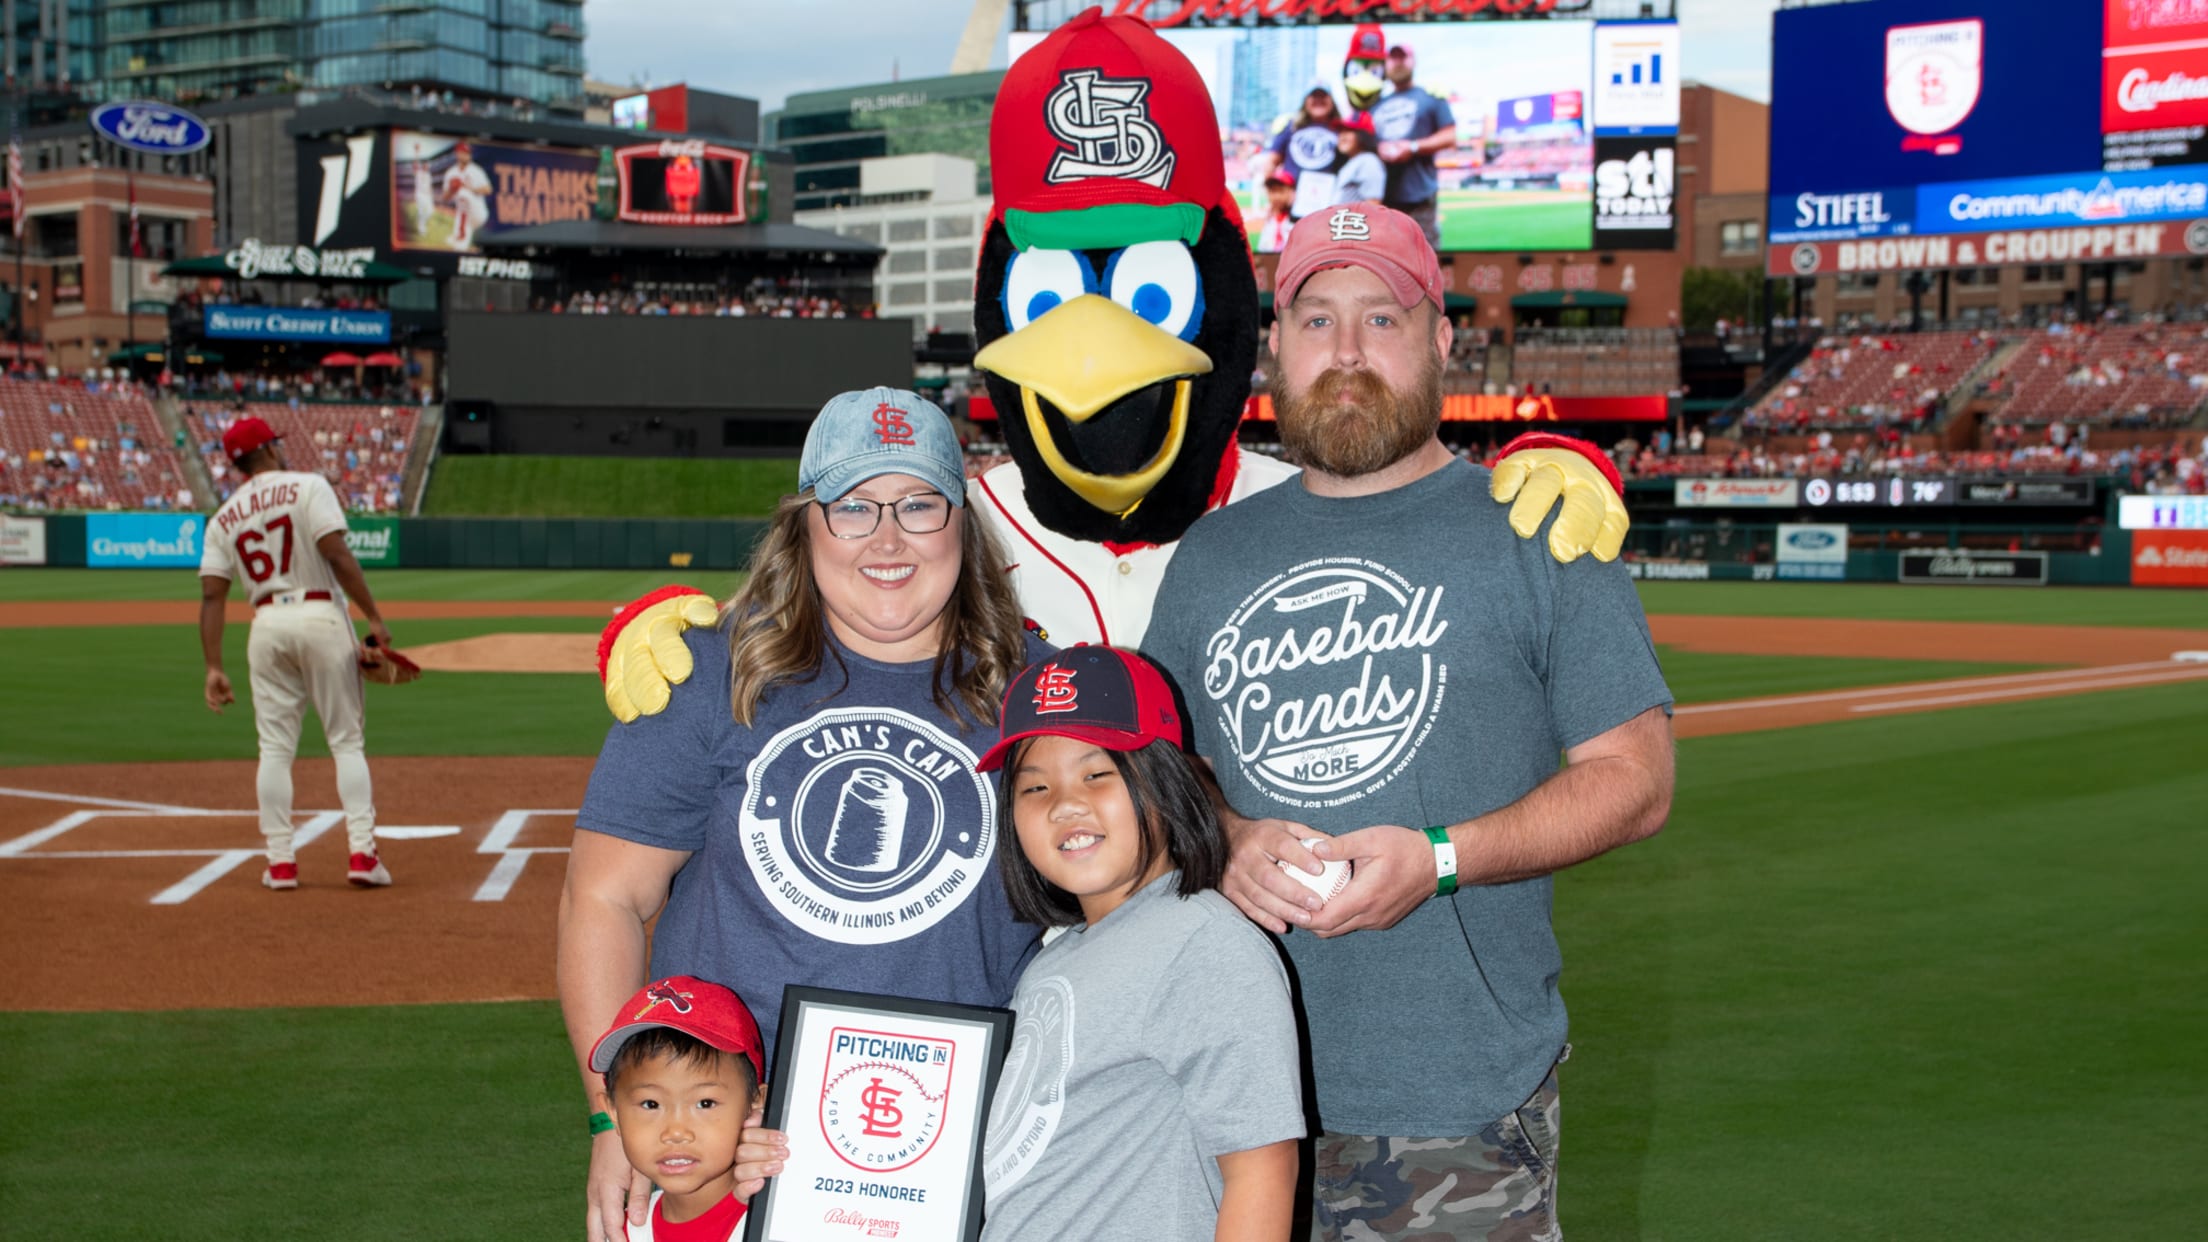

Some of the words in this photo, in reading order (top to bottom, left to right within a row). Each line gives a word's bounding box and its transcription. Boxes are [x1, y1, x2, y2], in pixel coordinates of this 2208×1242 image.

[117, 105, 188, 145] Ford
[494, 162, 598, 202] THANKS
[1596, 196, 1673, 215] TODAY
[1796, 191, 1890, 228] STIFEL
[1837, 237, 1950, 271] BROWN
[1957, 240, 1977, 263] &
[1985, 224, 2160, 261] CROUPPEN
[1468, 264, 1503, 292] 42
[217, 482, 300, 535] PALACIOS
[235, 514, 293, 583] 67
[344, 526, 391, 549] onal
[1240, 594, 1255, 609] THE
[1288, 558, 1323, 575] PROVIDE
[1363, 559, 1386, 573] FUND
[1384, 568, 1416, 594] SCHOOLS
[1290, 597, 1309, 607] ASK
[1311, 593, 1325, 601] ME
[1327, 585, 1351, 597] HOW
[1204, 585, 1448, 701] Baseball
[1438, 664, 1447, 683] BED
[1222, 655, 1415, 763] Cards
[1431, 685, 1445, 714] WARM
[1429, 715, 1437, 723] A
[1414, 722, 1432, 747] CHILD
[802, 724, 891, 759] CAN'S
[903, 738, 961, 782] CAN
[1294, 753, 1360, 782] MORE
[1393, 747, 1417, 776] FOSTER
[1366, 779, 1387, 794] GIVE
[1386, 774, 1394, 782] A
[1269, 791, 1302, 808] PROVIDE
[1303, 800, 1321, 808] JOB
[751, 831, 784, 883] SERVING
[779, 880, 840, 925] SOUTHERN
[842, 911, 896, 929] ILLINOIS
[900, 900, 925, 922] AND
[924, 868, 967, 908] BEYOND
[836, 1034, 929, 1063] PITCHING
[933, 1049, 947, 1063] IN
[828, 1100, 839, 1126] FOR
[837, 1133, 859, 1155] THE
[866, 1112, 936, 1163] COMMUNITY
[1002, 1154, 1019, 1176] AND
[1016, 1115, 1048, 1158] BEYOND
[814, 1177, 854, 1194] 2023
[859, 1182, 926, 1203] HONOREE
[823, 1207, 868, 1230] Bally
[867, 1218, 900, 1231] SPORTS
